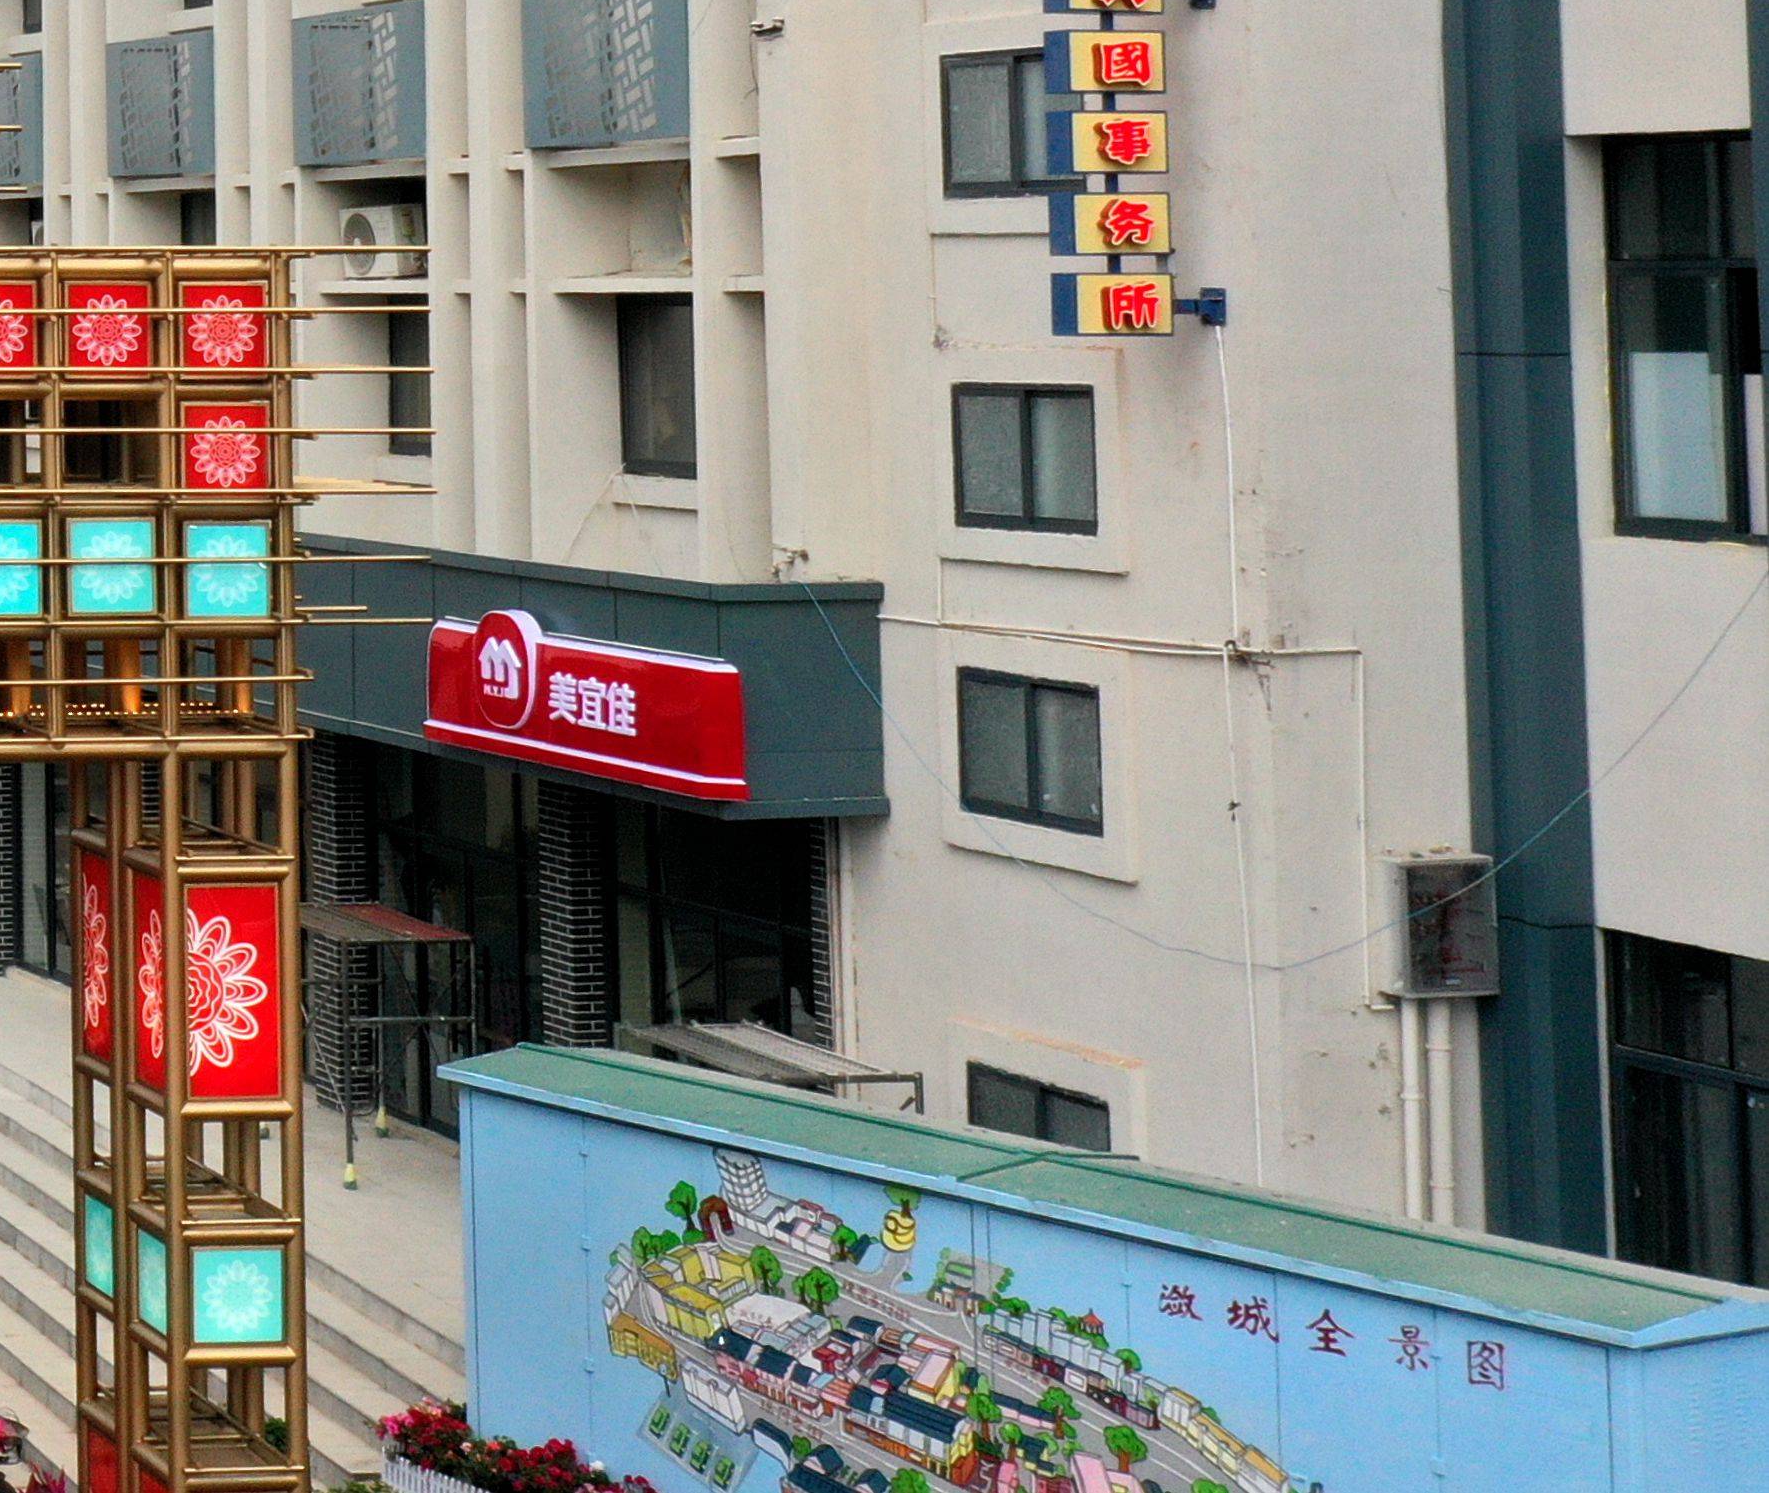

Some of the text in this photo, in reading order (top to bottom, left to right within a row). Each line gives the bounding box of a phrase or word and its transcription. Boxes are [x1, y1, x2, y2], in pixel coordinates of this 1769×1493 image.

[548, 671, 637, 737] 美宜佳
[1158, 1282, 1506, 1392] 潋城全景图
